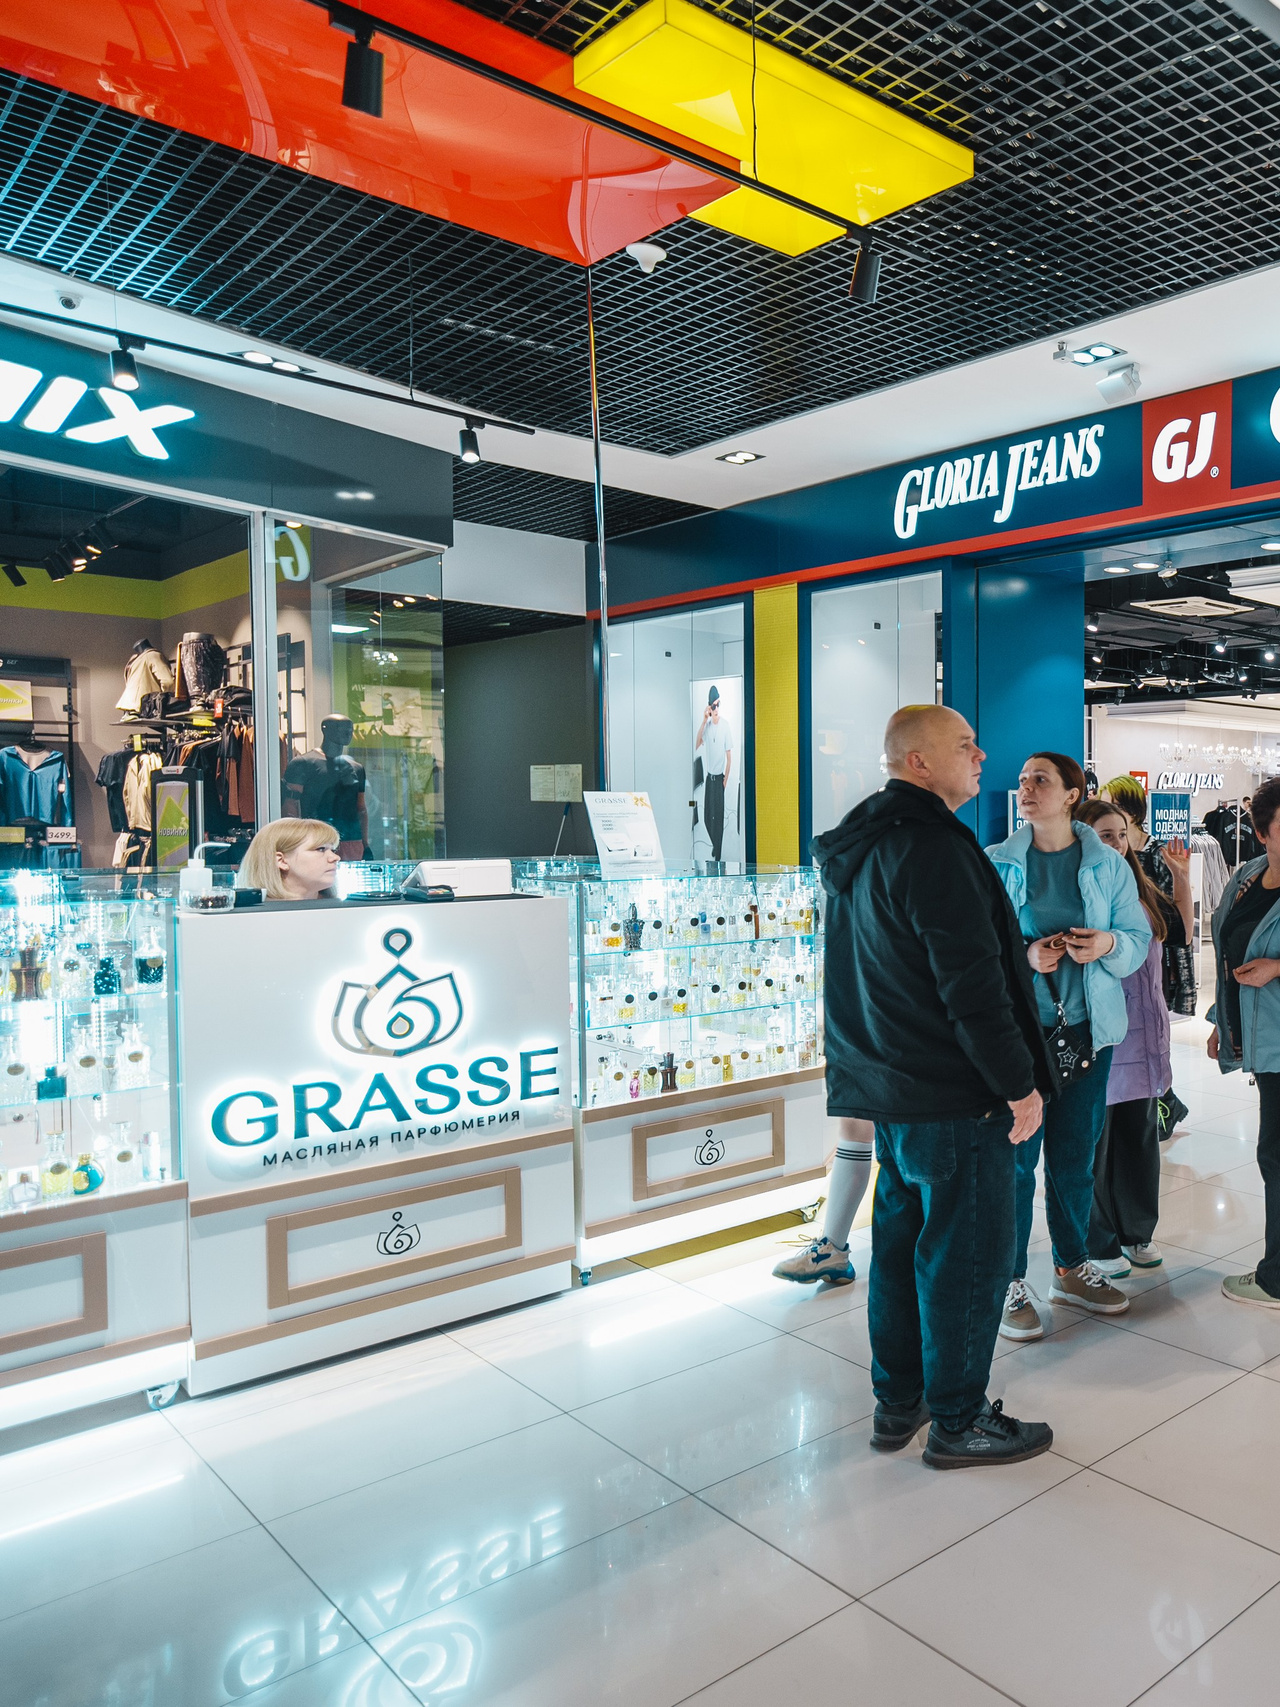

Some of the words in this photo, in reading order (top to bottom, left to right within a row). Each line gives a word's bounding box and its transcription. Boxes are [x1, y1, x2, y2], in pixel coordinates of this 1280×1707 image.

[0, 359, 196, 460] IX
[894, 451, 999, 539] GLORIA
[993, 424, 1105, 523] JEANS
[1155, 809, 1188, 821] МОДНАЯ
[1155, 822, 1187, 833] ОДЕЖДА
[211, 1047, 560, 1147] GRASSE
[263, 1136, 379, 1166] МАСЛЯНАЯ
[391, 1110, 521, 1143] ПАРФЮМЕРИЯ
